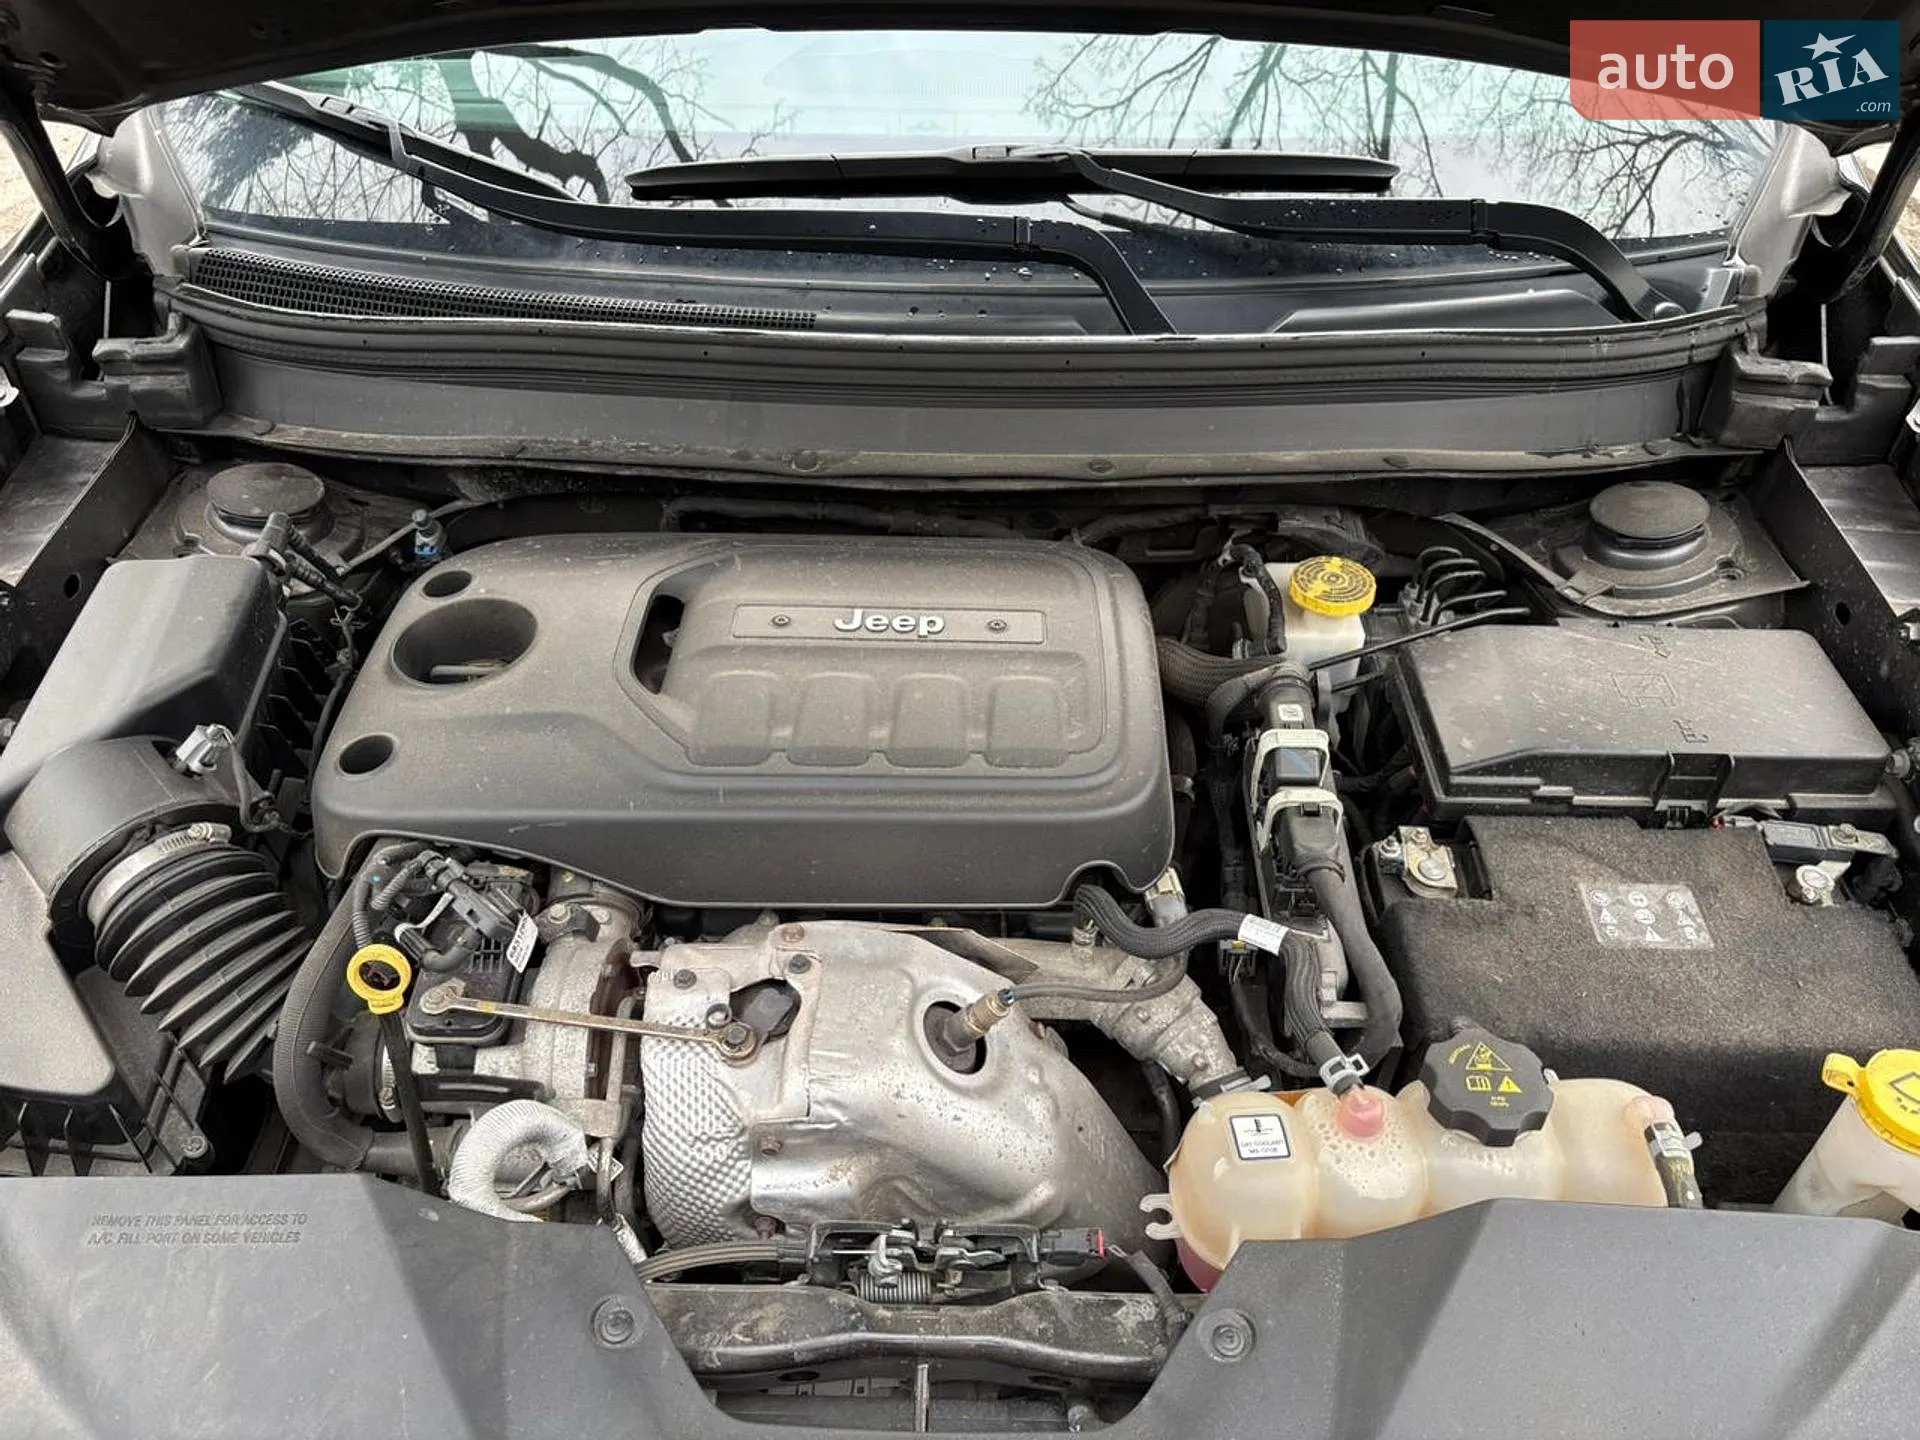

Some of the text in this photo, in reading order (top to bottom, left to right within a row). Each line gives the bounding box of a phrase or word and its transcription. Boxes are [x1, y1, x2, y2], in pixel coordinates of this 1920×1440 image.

[834, 609, 945, 638] Jeep
[92, 1212, 308, 1227] REMOVE THIS PANEL FOR ACCESS TO
[87, 1231, 301, 1245] A/C FILL PORT ON SOME VEHICLES
